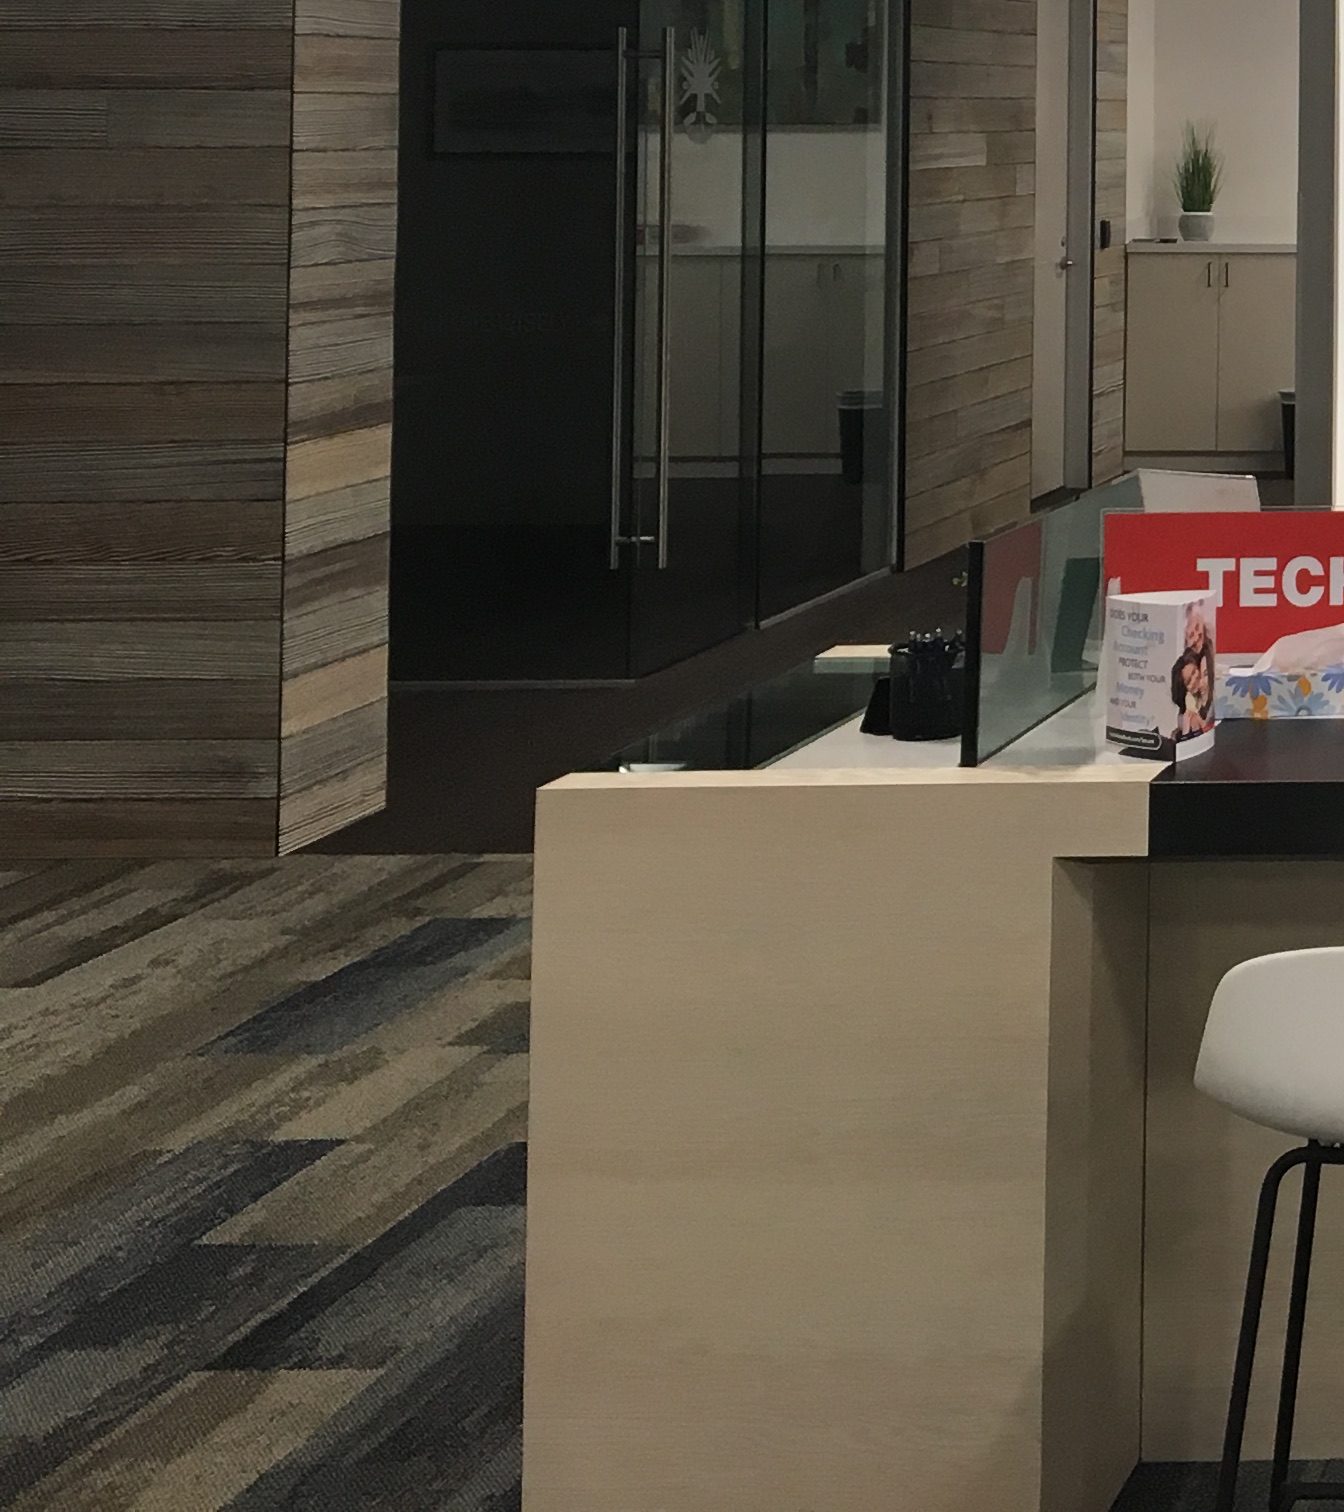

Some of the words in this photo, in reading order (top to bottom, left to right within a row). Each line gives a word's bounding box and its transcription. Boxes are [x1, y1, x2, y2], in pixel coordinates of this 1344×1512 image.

[1127, 612, 1149, 622] YOUR
[1121, 625, 1164, 644] Checking
[1118, 657, 1148, 669] PROTECT
